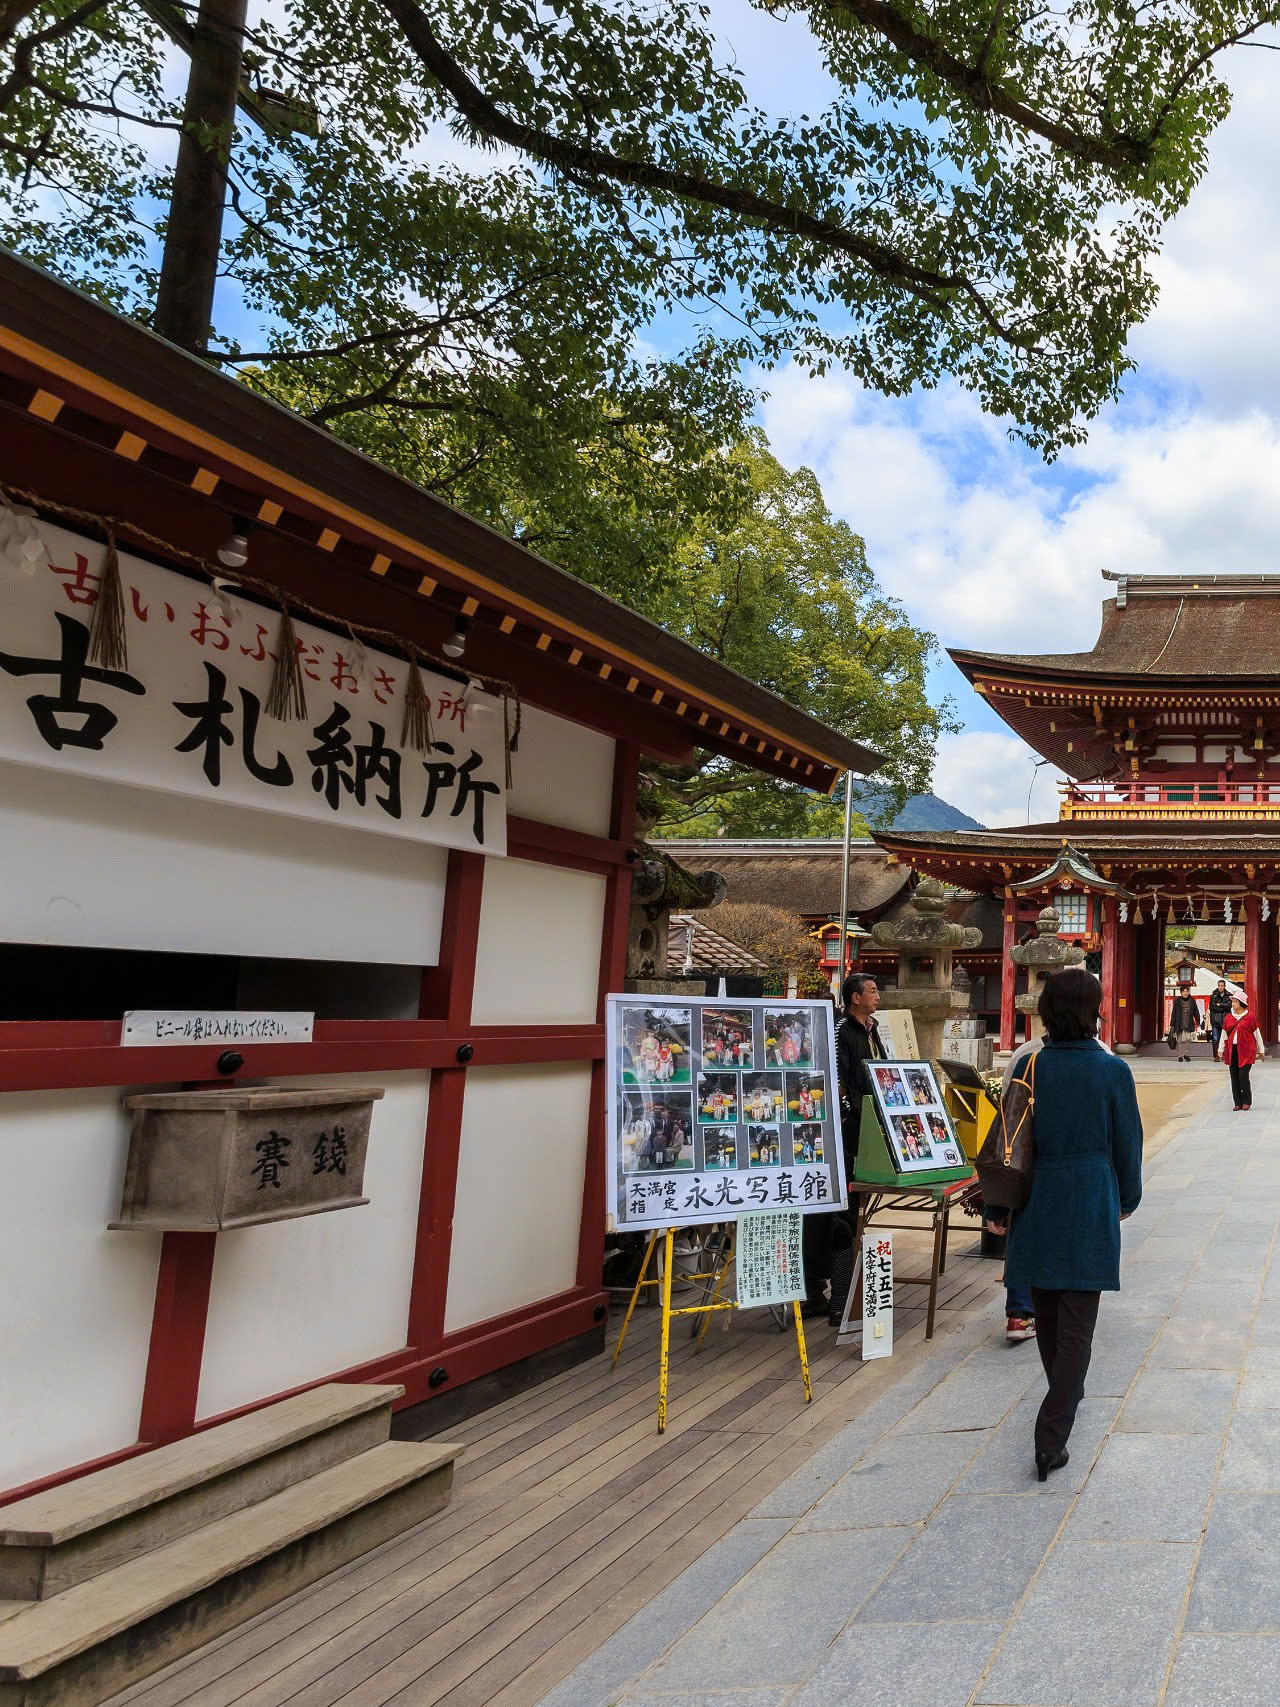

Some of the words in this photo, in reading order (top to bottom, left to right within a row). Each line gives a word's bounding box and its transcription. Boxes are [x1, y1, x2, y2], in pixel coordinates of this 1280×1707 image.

[48, 552, 468, 733] 古いおふだおさ所
[0, 611, 501, 845] 古札納所
[630, 1180, 677, 1198] 天満宮
[630, 1197, 679, 1214] 指定
[684, 1171, 827, 1208] 永光写真館
[789, 1213, 800, 1290] 修学旅行関係者様各位
[864, 1246, 878, 1318] 太宰府天満宮
